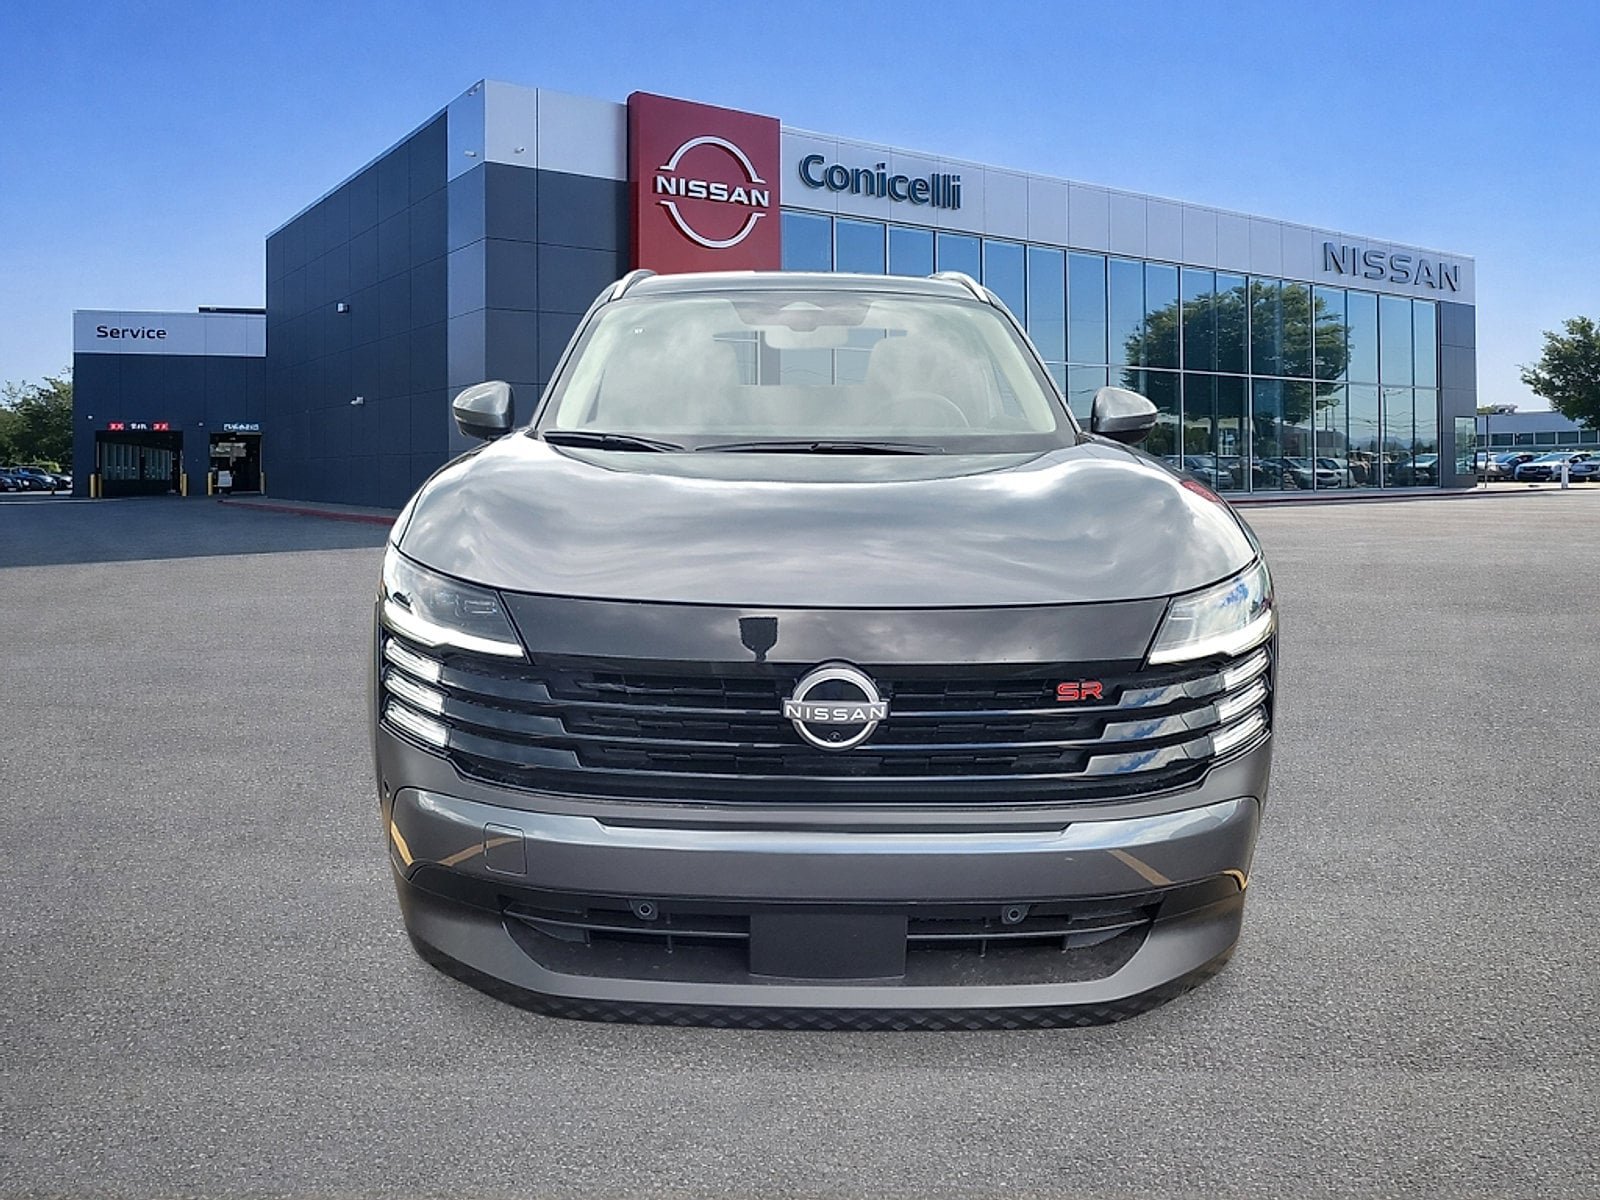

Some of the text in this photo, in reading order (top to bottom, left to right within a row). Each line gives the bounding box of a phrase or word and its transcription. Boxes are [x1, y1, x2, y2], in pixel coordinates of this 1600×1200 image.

[655, 174, 769, 208] NISSAN
[799, 154, 961, 210] Conicelli
[1323, 242, 1461, 292] NISSAN
[96, 325, 167, 339] Service
[1056, 681, 1103, 701] SR
[785, 705, 885, 720] NISSAN
